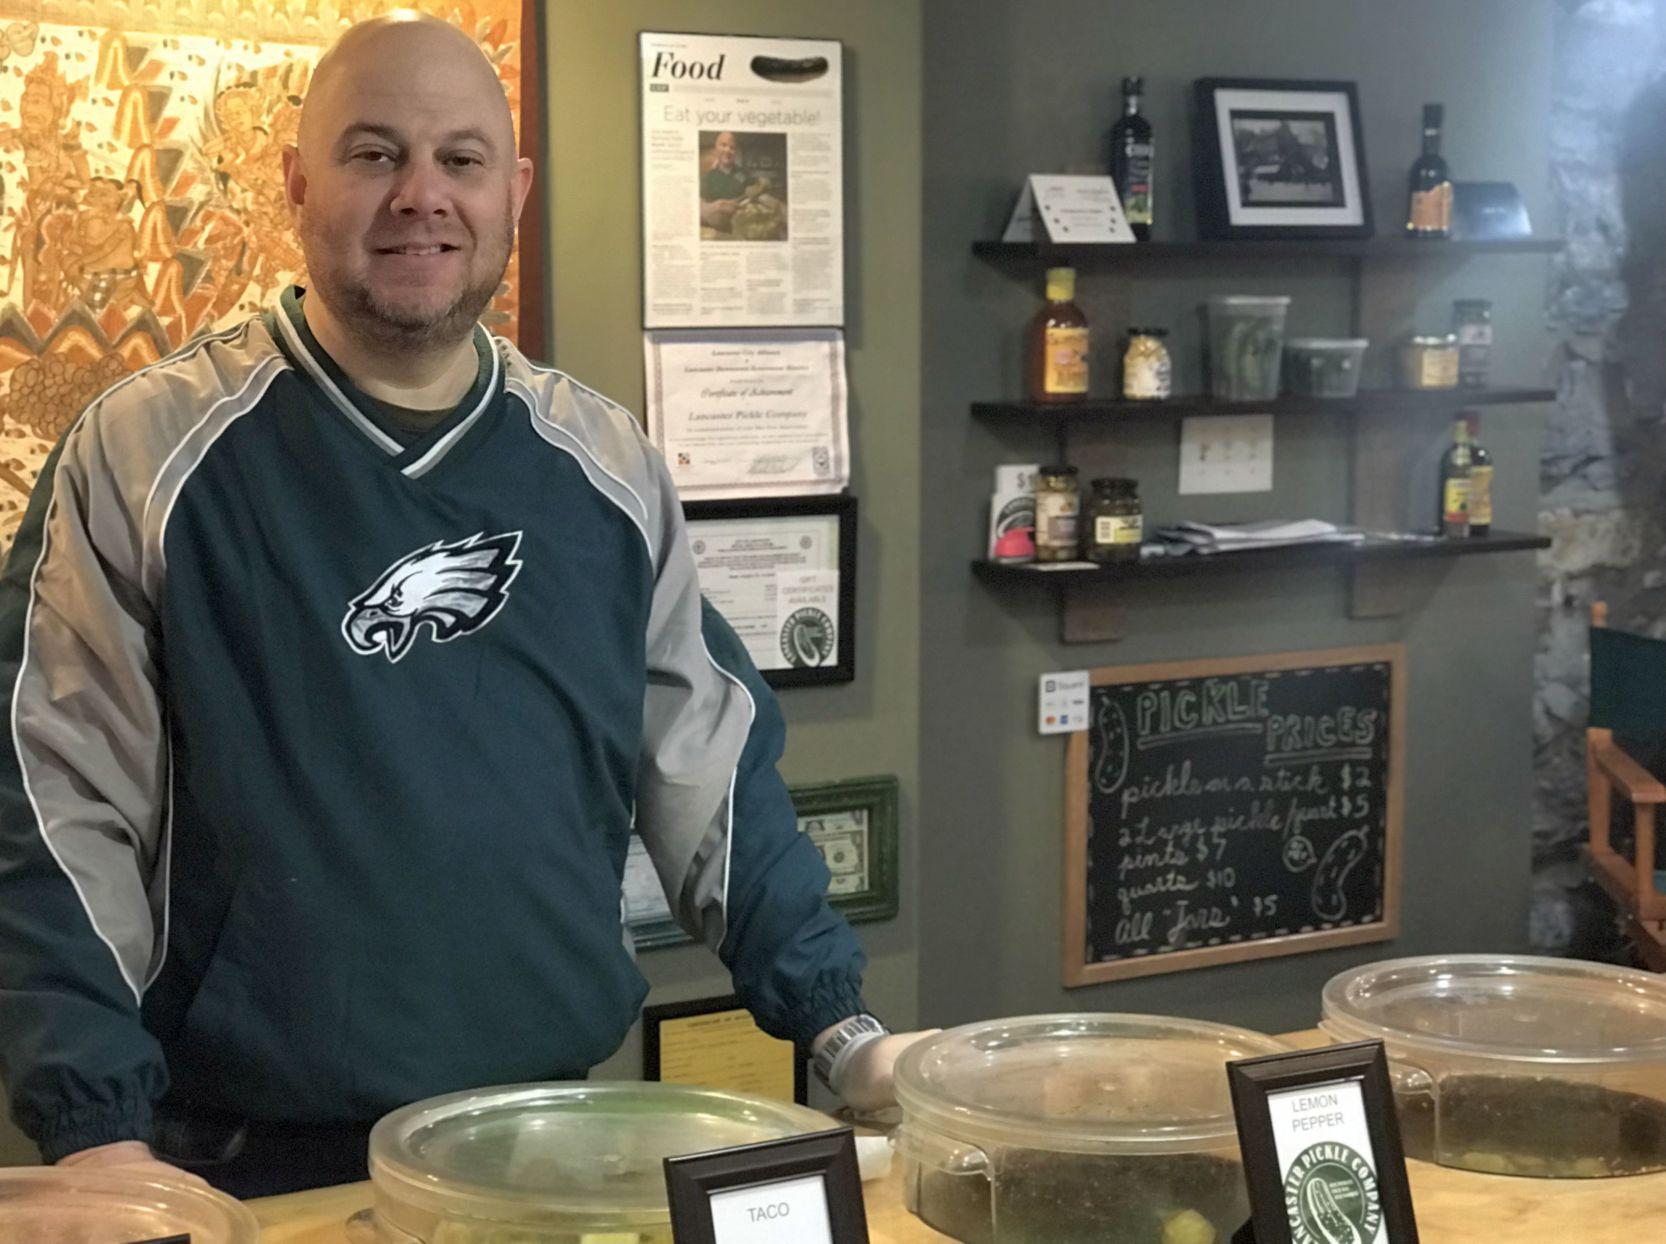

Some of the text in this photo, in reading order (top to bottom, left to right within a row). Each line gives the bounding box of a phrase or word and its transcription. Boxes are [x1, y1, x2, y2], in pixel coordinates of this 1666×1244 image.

[651, 51, 726, 81] Food
[664, 105, 821, 128] Eat your vegetable!
[688, 409, 808, 422] Lancaster Pickle Company
[1136, 677, 1270, 736] PICKLE
[1265, 705, 1378, 751] PRICES
[1120, 758, 1202, 820] pickle
[1258, 763, 1329, 796] stick
[1340, 763, 1373, 792] $2
[1340, 794, 1371, 818] $5
[1117, 839, 1190, 881] pints
[1116, 865, 1237, 916] quarts $10
[1252, 893, 1280, 918] $5
[1291, 1093, 1339, 1113] LEMON
[1291, 1111, 1345, 1132] PEPPER
[1300, 1144, 1350, 1169] PICKLE
[1351, 1156, 1380, 1235] COMPANY
[747, 1201, 791, 1223] TACO
